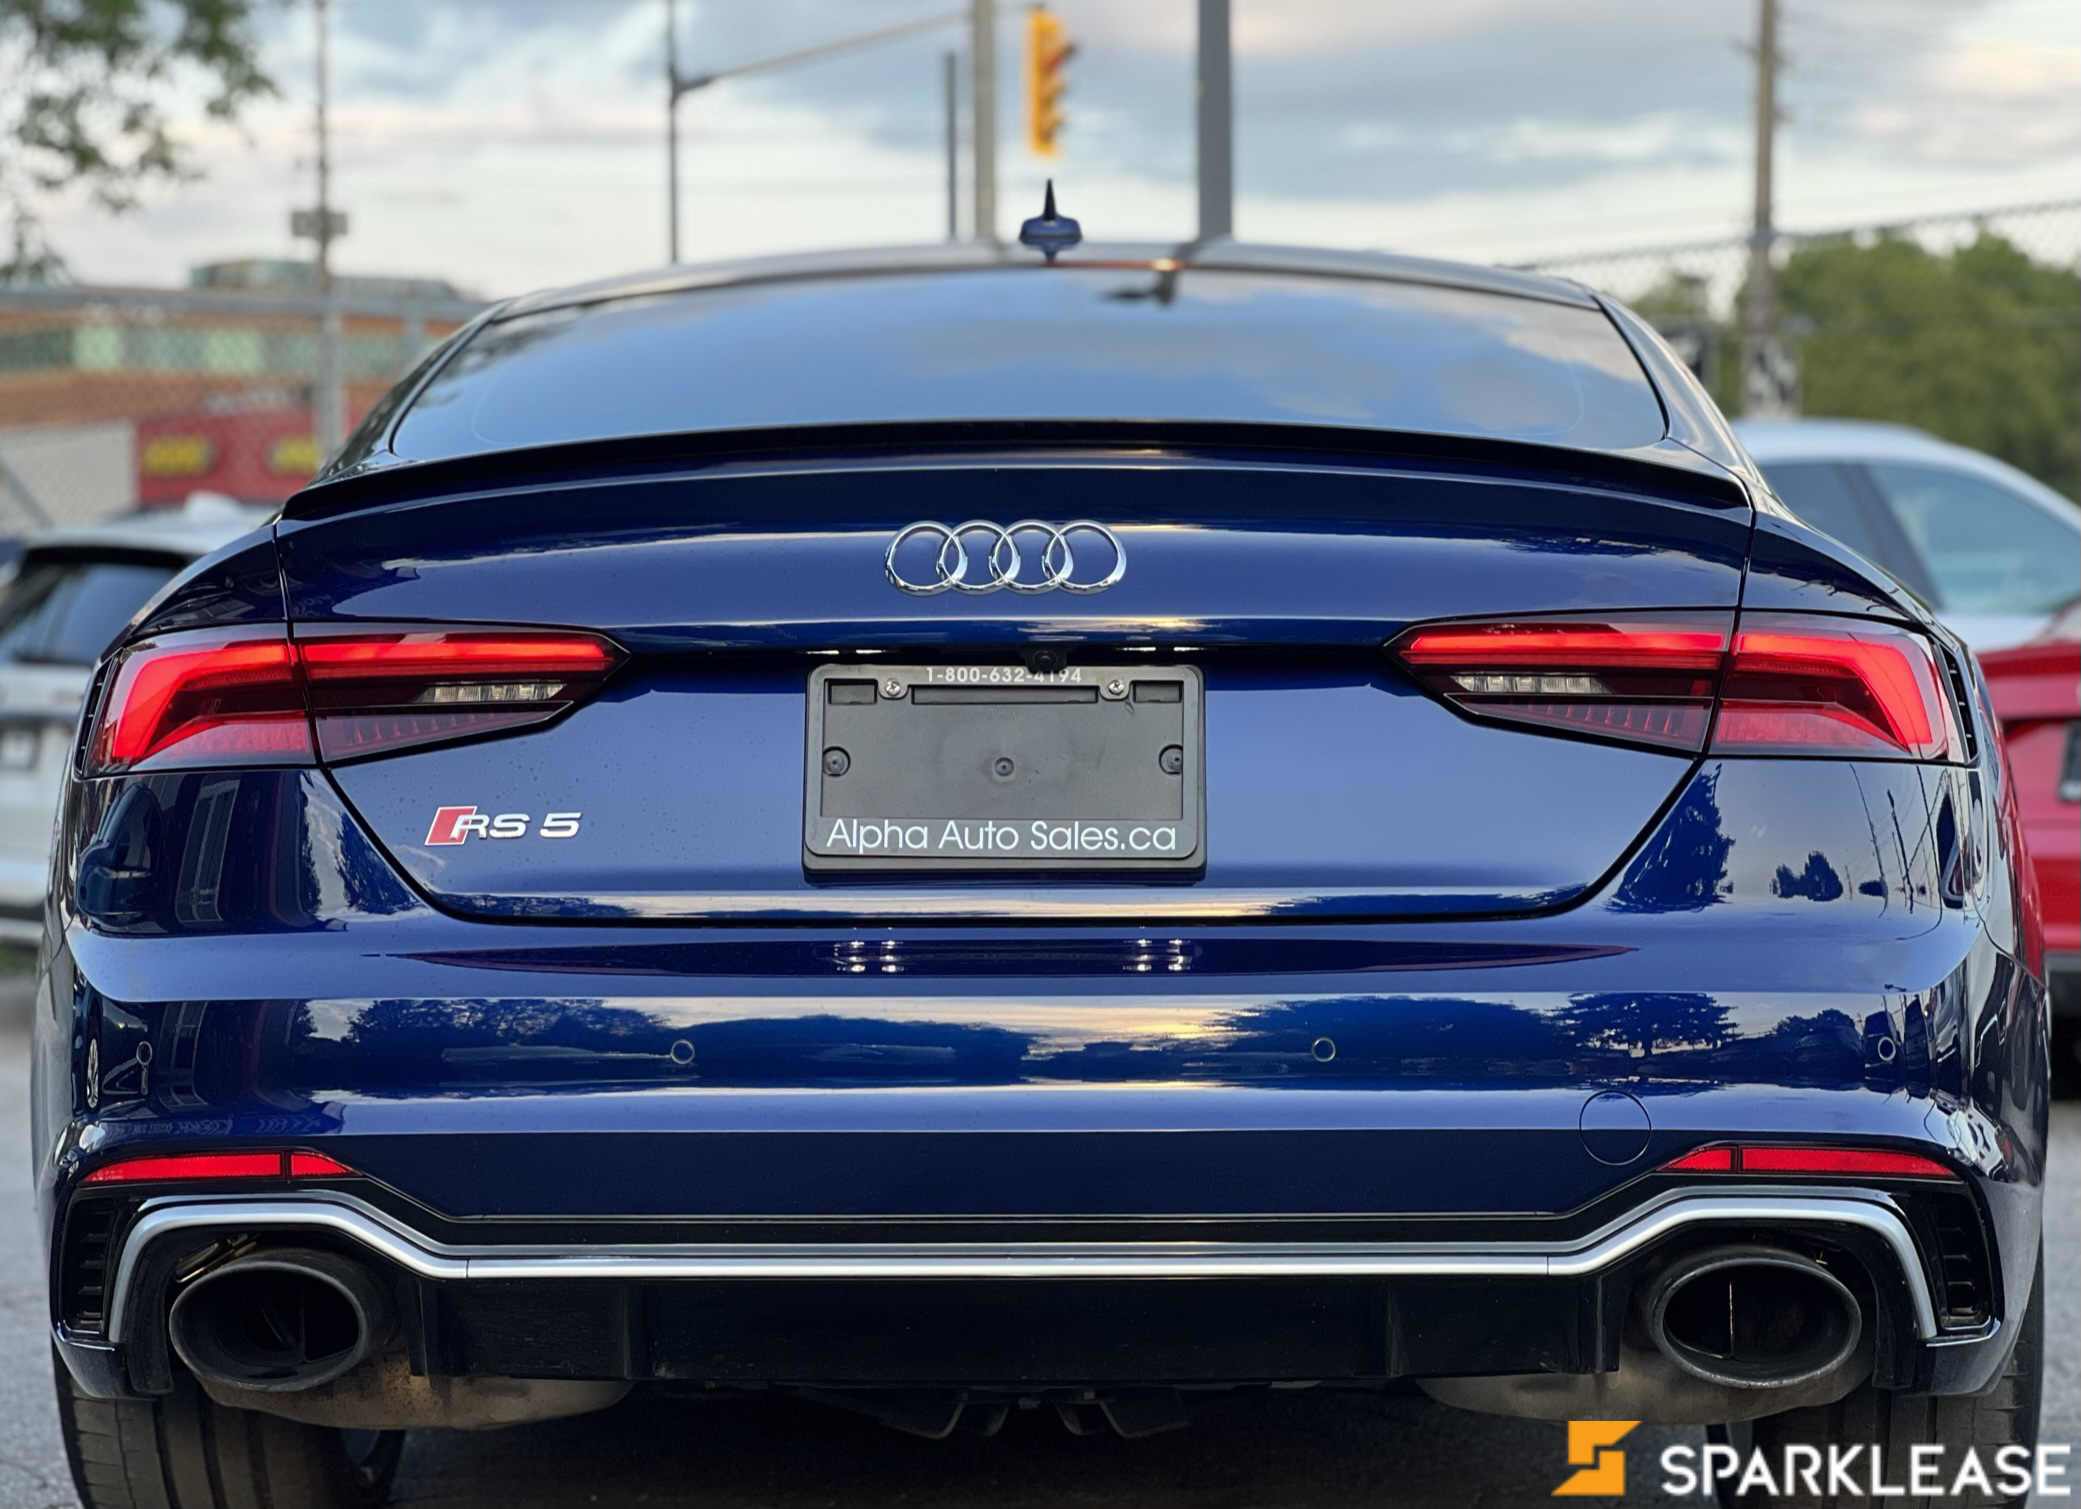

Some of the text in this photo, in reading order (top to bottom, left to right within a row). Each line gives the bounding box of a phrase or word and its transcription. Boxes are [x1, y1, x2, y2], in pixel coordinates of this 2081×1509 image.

[449, 812, 582, 840] RS 5
[826, 819, 1176, 854] Alpha Auto Sales.ca
